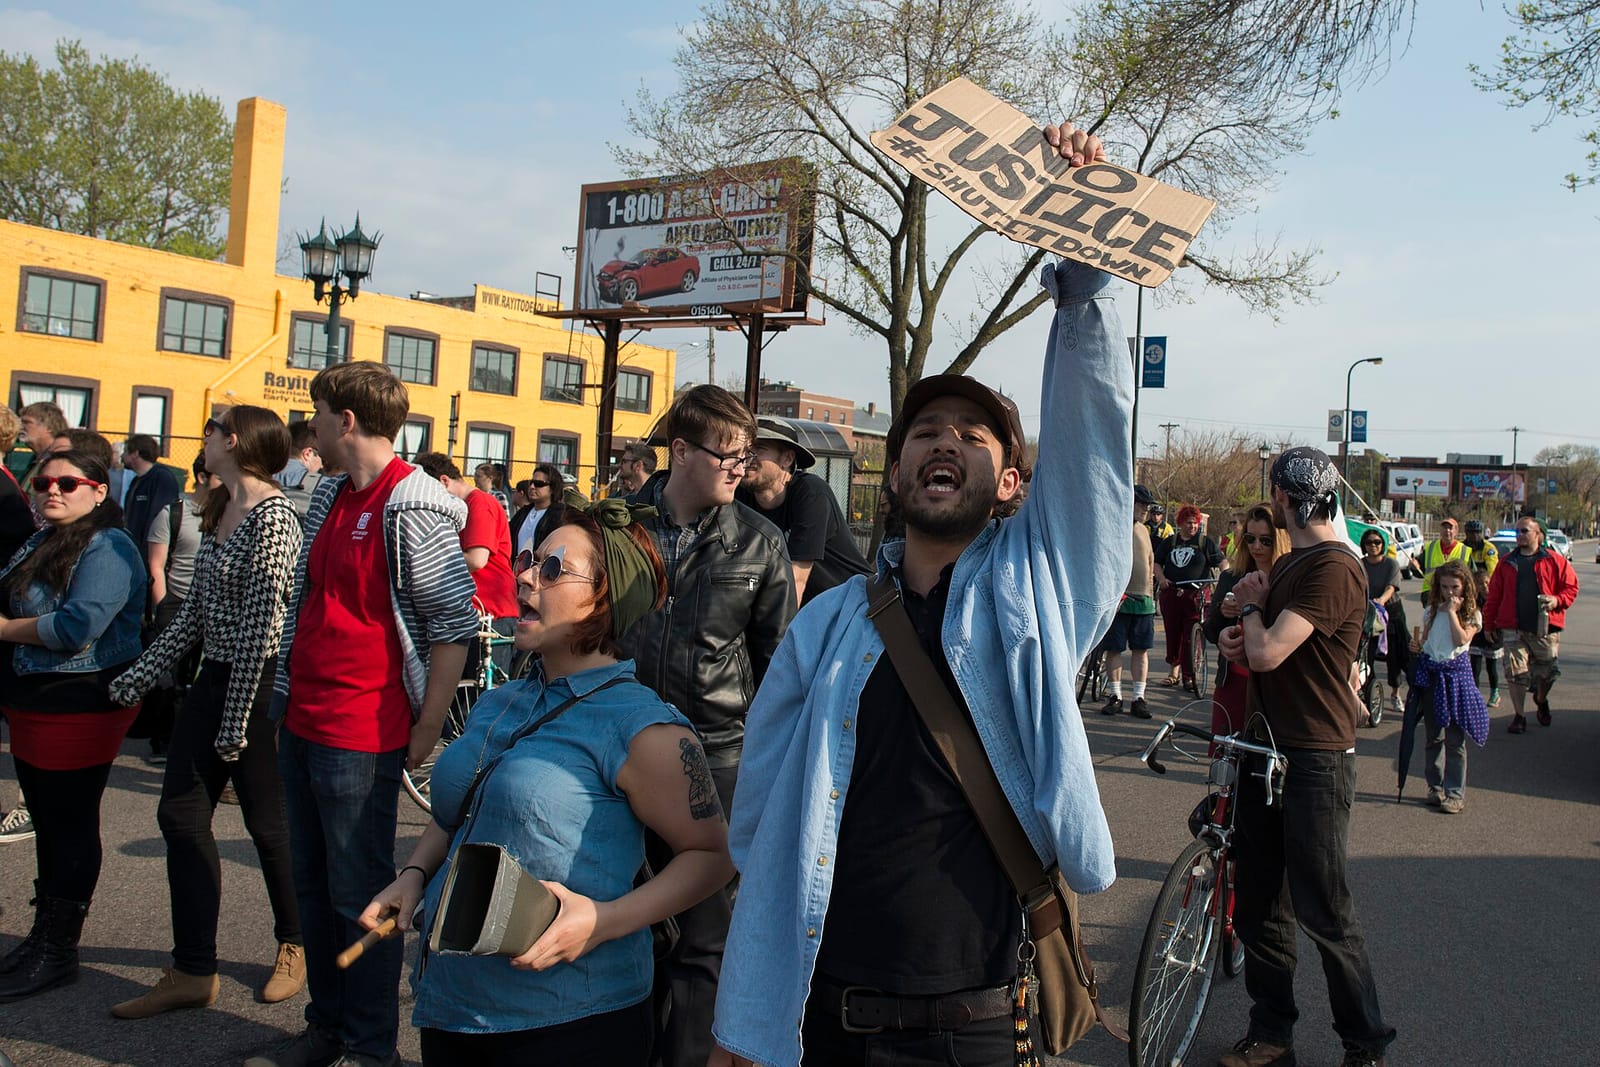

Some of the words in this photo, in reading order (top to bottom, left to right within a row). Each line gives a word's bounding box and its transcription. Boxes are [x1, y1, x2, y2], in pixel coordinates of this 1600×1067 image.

[1010, 125, 1137, 194] NO
[898, 102, 1193, 272] JUSTICE
[607, 192, 665, 225] 1-800
[714, 257, 735, 270] CALL
[736, 255, 757, 268] 24/7
[690, 305, 722, 315] 015140
[264, 371, 309, 390] Rayit
[263, 394, 289, 403] Early
